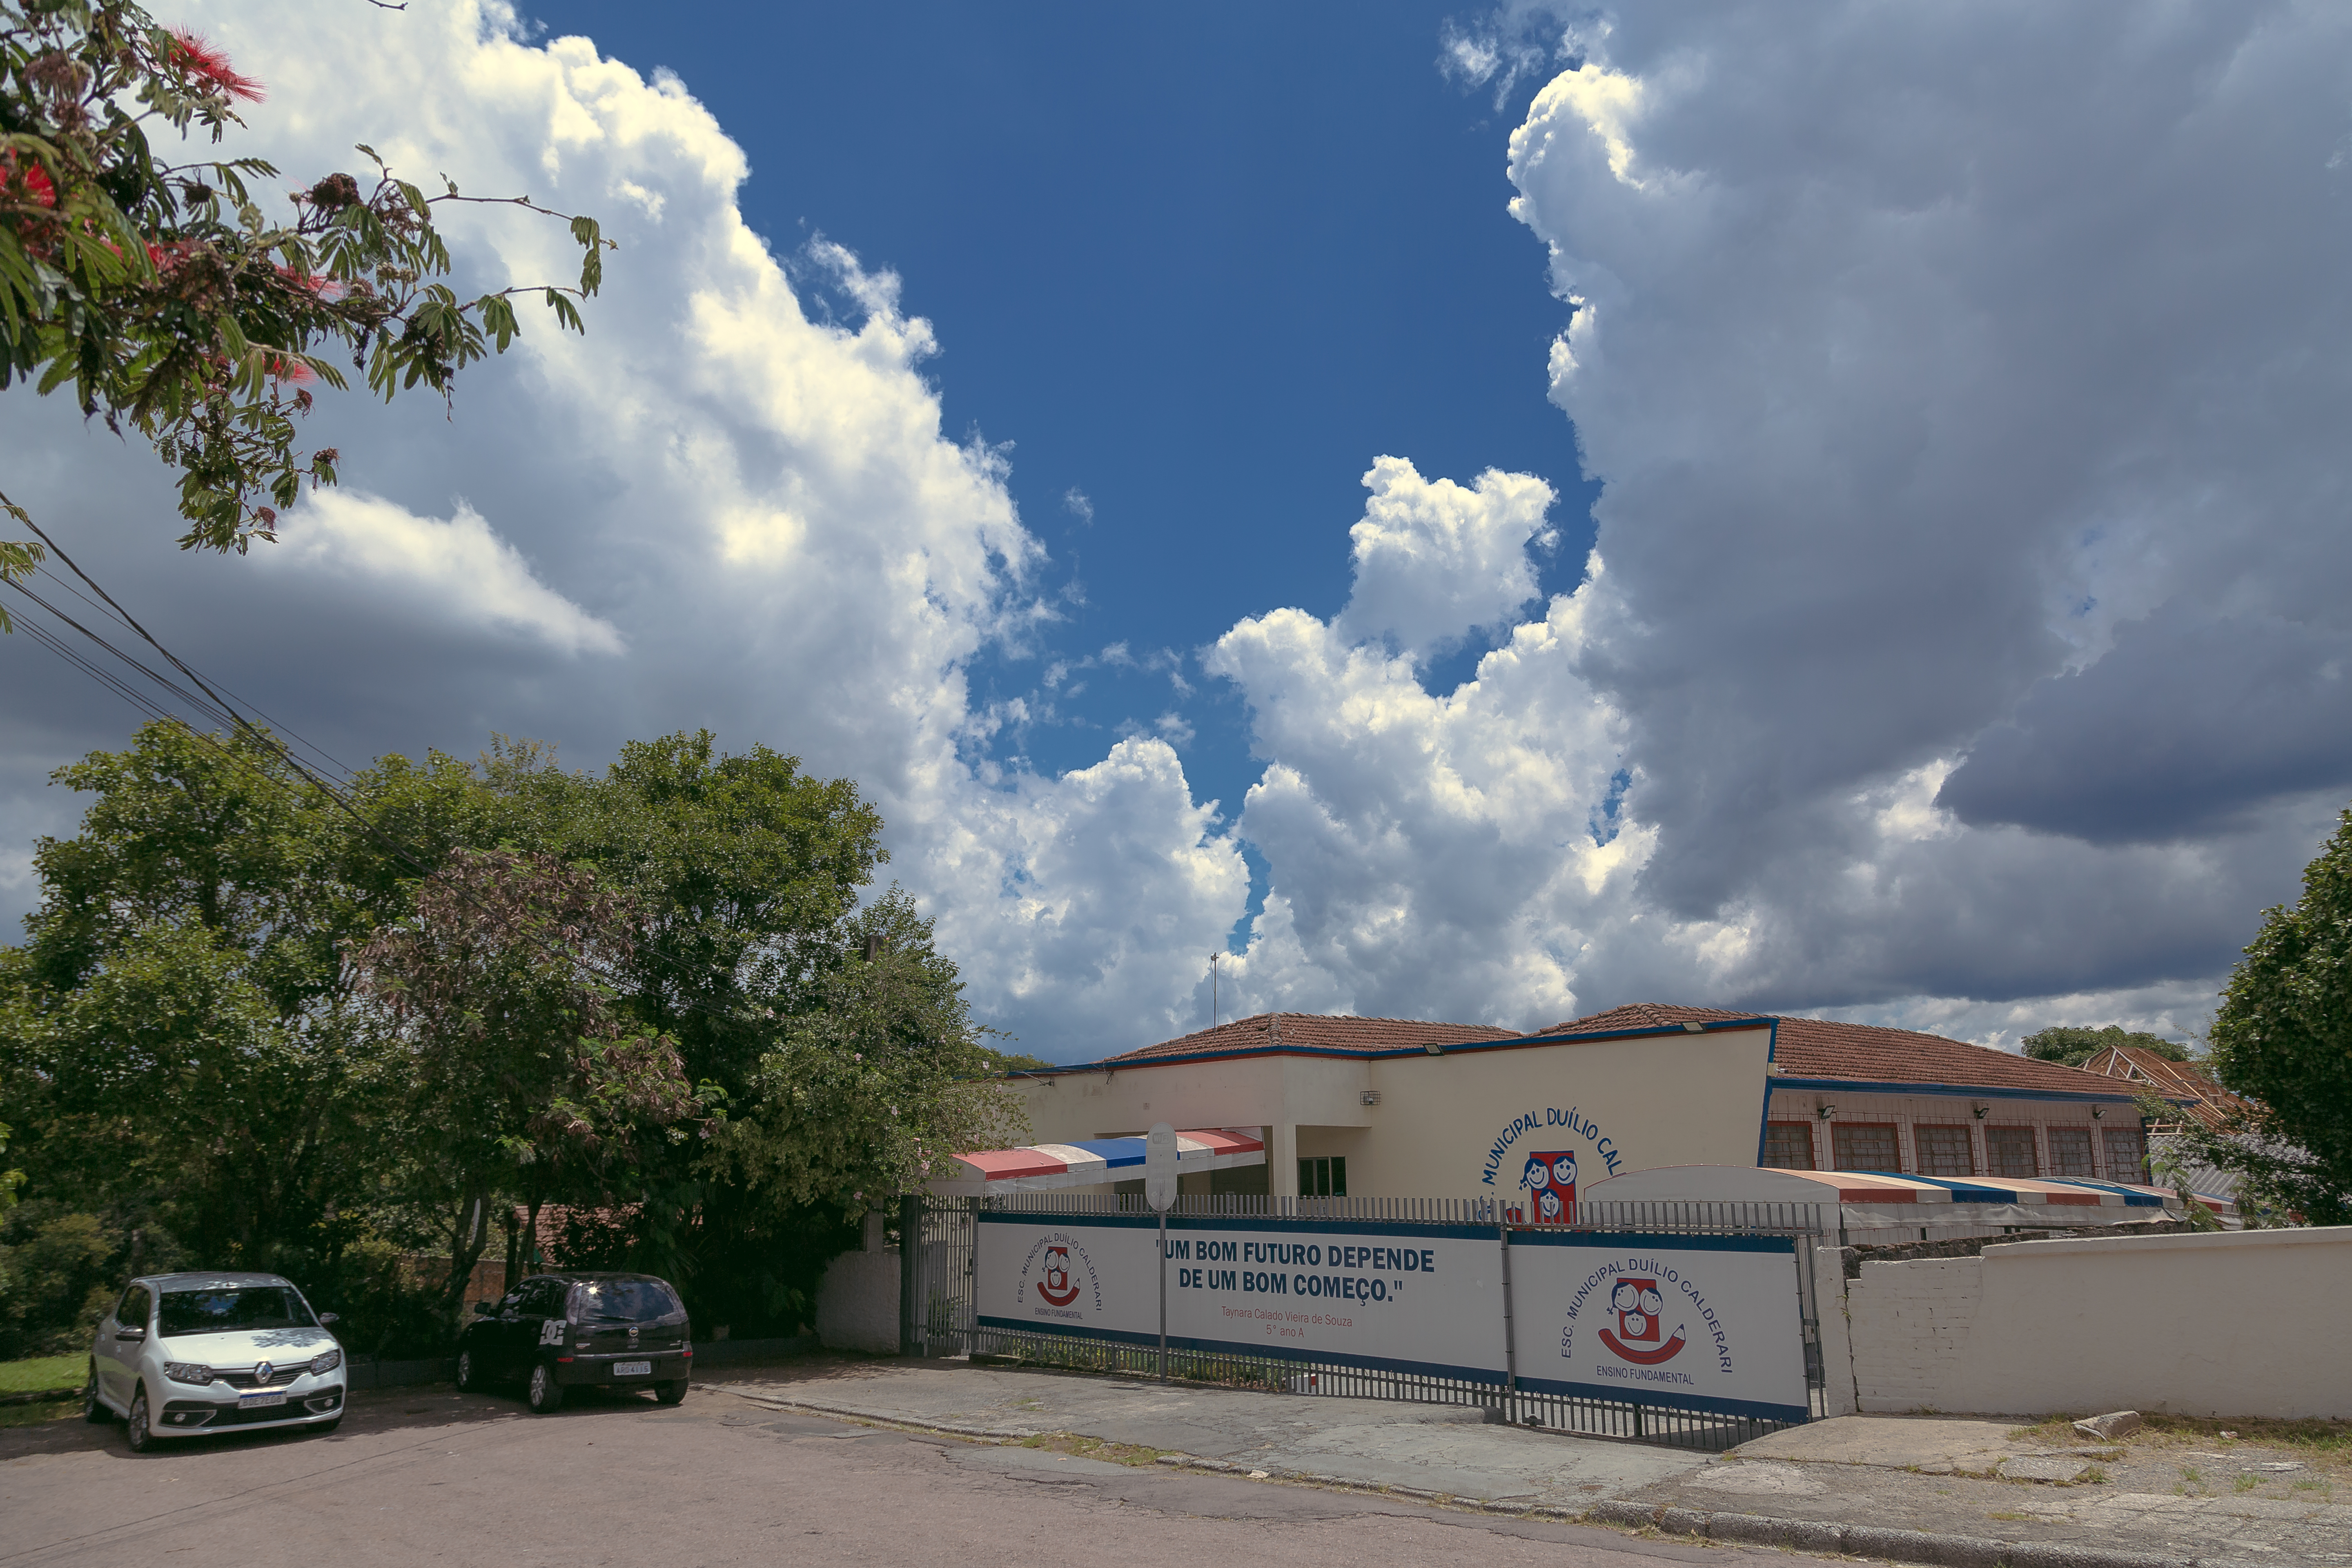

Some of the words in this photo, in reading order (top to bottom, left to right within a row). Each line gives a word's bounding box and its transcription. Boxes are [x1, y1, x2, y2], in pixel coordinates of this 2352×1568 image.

[1482, 1110, 1544, 1186] MUNICIPAL
[1547, 1106, 1598, 1140] DUÍLIO
[1597, 1137, 1626, 1177] CAL
[1018, 1279, 1026, 1303] ESC.
[1022, 1234, 1053, 1276] MUNICIPAL
[1054, 1232, 1079, 1250] DUÍLIO
[1079, 1247, 1102, 1311] CALDERARI
[1196, 1240, 1237, 1262] BOM
[1244, 1242, 1321, 1266] FUTURO
[1328, 1245, 1435, 1273] DEPENDE
[1629, 1258, 1678, 1283] DUÍLIO
[1179, 1268, 1203, 1289] DE
[1208, 1269, 1236, 1291] UM
[1243, 1271, 1287, 1294] BOM
[1293, 1274, 1403, 1307] COMEÇO."
[1567, 1261, 1625, 1320] MUNICIPAL
[1035, 1307, 1051, 1316] ENSINO
[1051, 1309, 1083, 1320] FUNDAMENTAL
[1221, 1306, 1252, 1319] Taynara
[1254, 1308, 1283, 1321] Calado
[1285, 1310, 1309, 1323] Vieira
[1312, 1313, 1323, 1324] de
[1325, 1314, 1352, 1327] Souza
[1681, 1280, 1733, 1373] CALDERARI
[1280, 1327, 1296, 1337] ano
[1298, 1327, 1304, 1338] A
[1561, 1324, 1575, 1359] ESC.
[1596, 1365, 1628, 1379] ENSINO
[1630, 1368, 1695, 1385] FUNDAMENTAL
